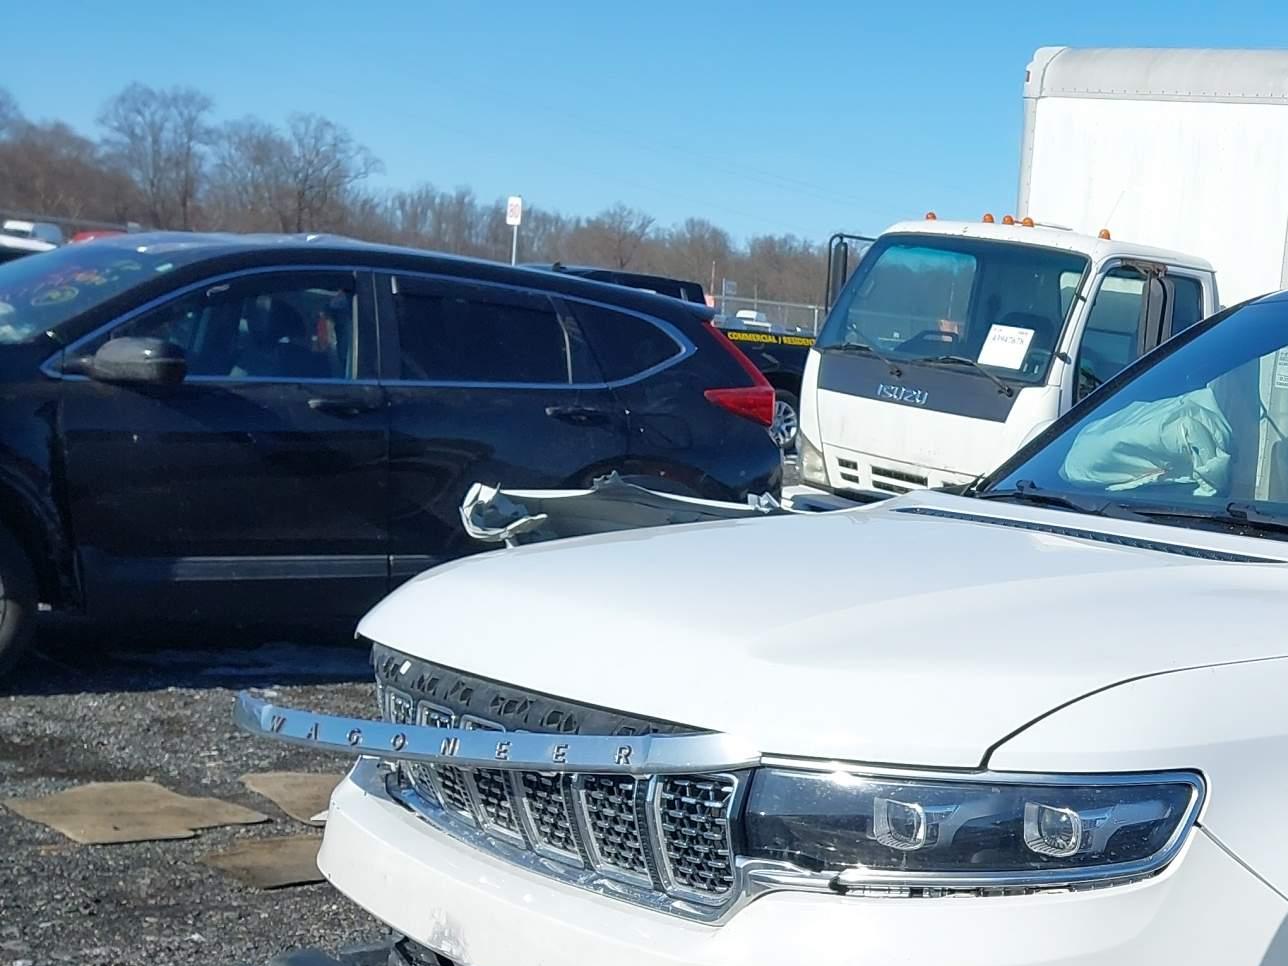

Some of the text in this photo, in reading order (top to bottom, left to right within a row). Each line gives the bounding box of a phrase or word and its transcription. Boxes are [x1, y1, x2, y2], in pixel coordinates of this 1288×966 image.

[727, 331, 778, 344] COMMERCIAL
[877, 383, 929, 405] ISUZU
[269, 714, 634, 765] WAGONEER
